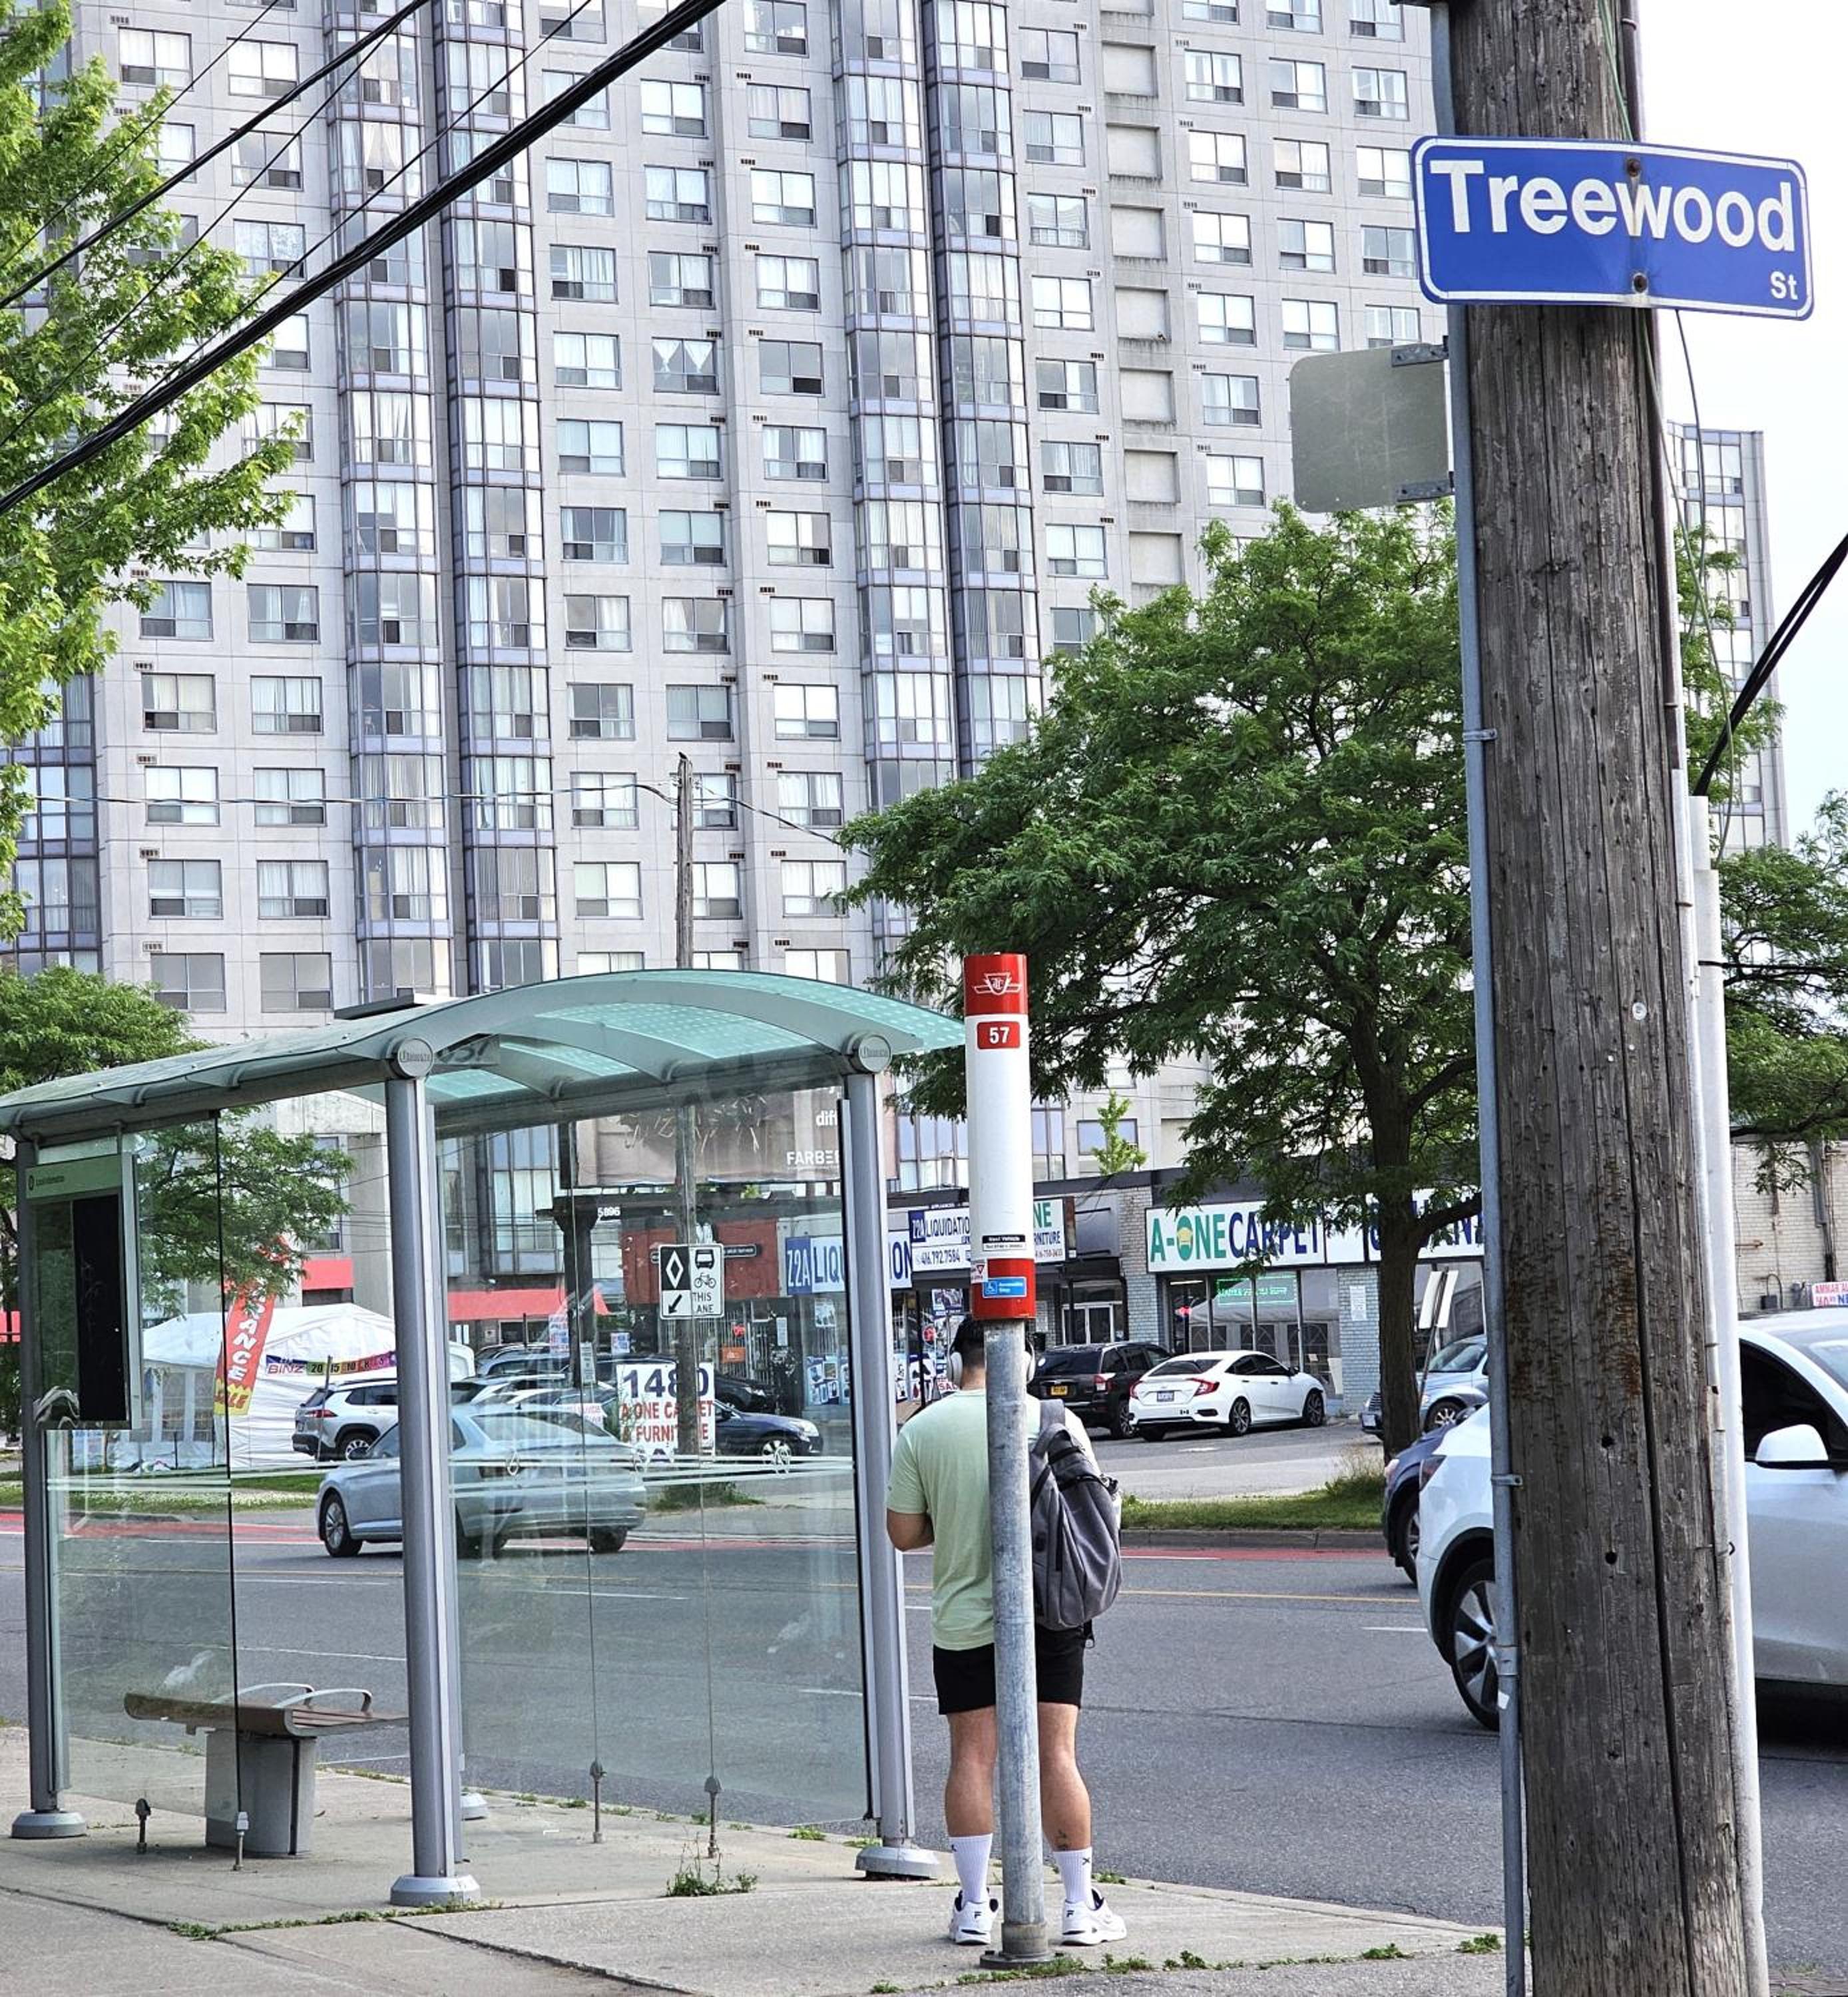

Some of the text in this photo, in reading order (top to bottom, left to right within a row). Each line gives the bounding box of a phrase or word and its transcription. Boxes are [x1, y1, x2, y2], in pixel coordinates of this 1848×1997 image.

[1429, 160, 1796, 252] Treewood
[1770, 271, 1799, 300] St
[989, 1026, 1010, 1044] 57
[1150, 1214, 1227, 1262] A-ONE
[1228, 1211, 1318, 1259] CARPET
[787, 1245, 844, 1287] Z2A LIQ
[888, 1240, 911, 1279] ON
[692, 1292, 712, 1302] THIS
[696, 1304, 714, 1313] ANE
[311, 1364, 323, 1373] 20
[330, 1364, 340, 1373] 15
[622, 1368, 709, 1399] 1480
[634, 1401, 660, 1420] ONE
[664, 1401, 713, 1419] CAET
